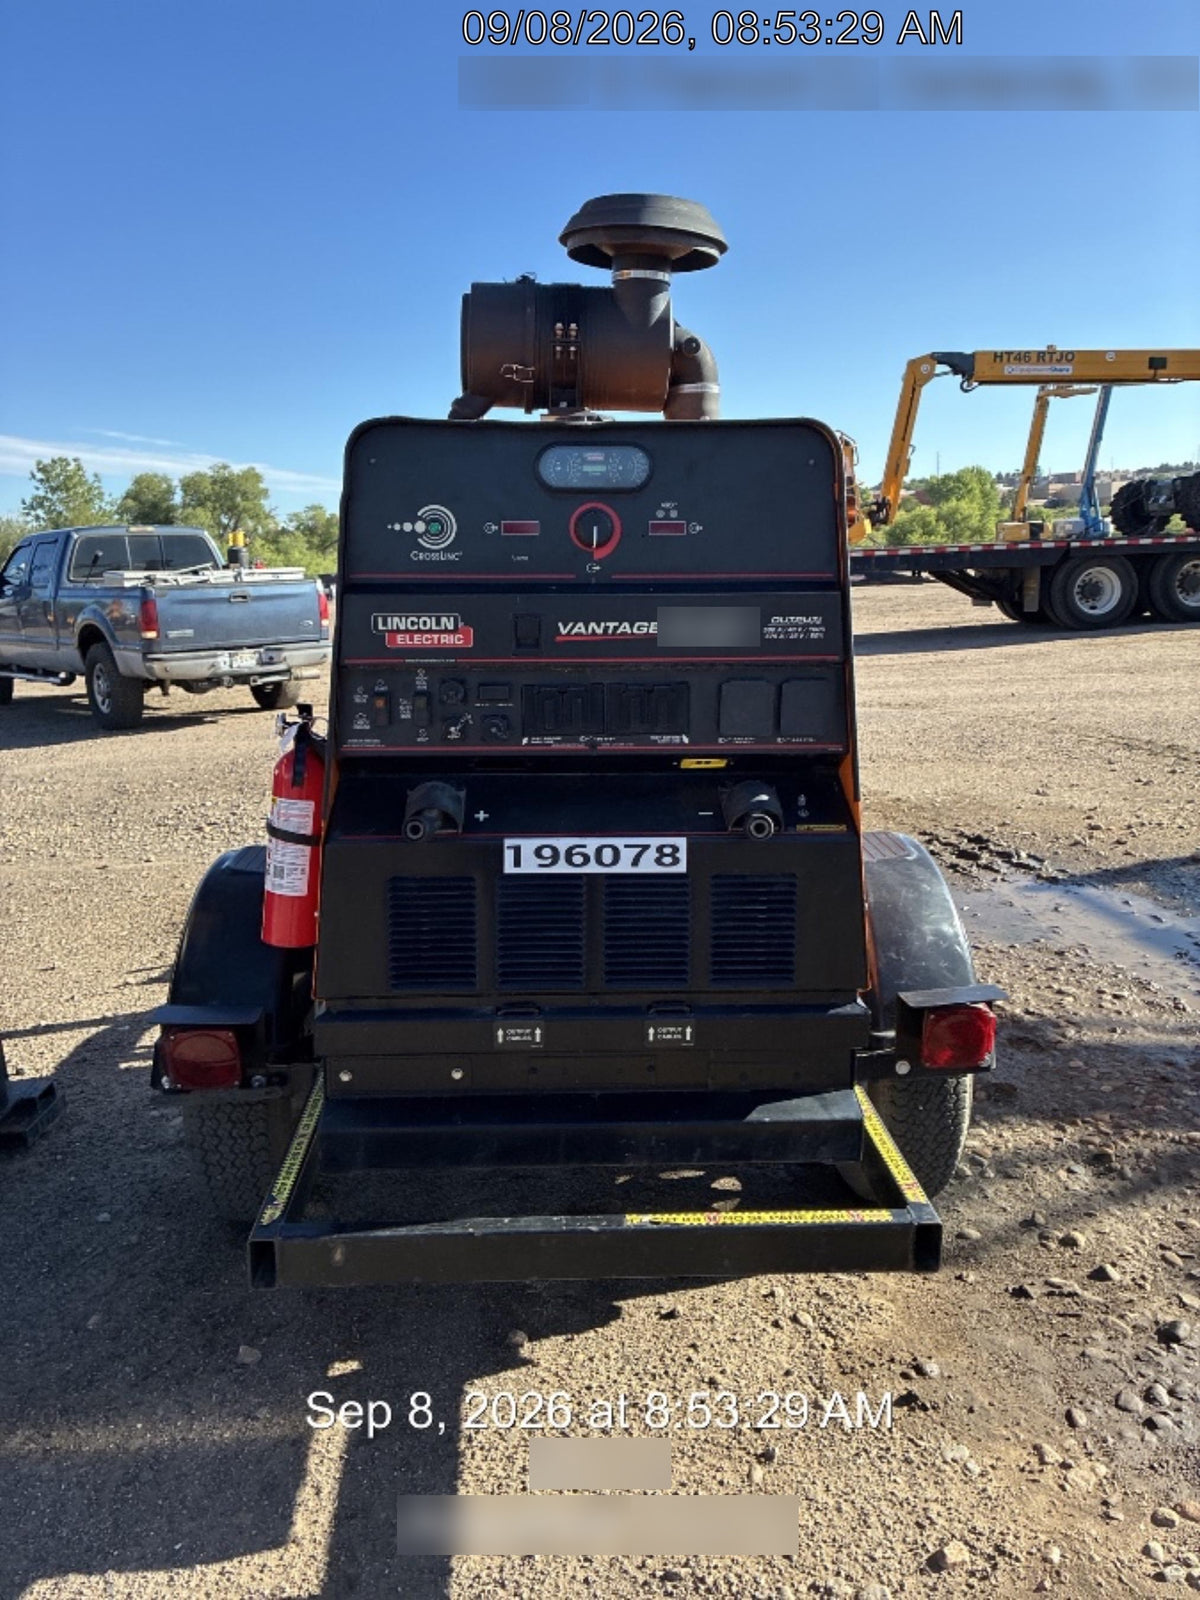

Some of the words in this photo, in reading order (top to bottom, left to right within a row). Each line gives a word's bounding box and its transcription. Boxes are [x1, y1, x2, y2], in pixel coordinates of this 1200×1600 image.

[993, 351, 1032, 363] HT46
[377, 616, 455, 631] LINCOLN
[396, 634, 465, 645] ELECTRIC
[506, 843, 681, 868] 196078
